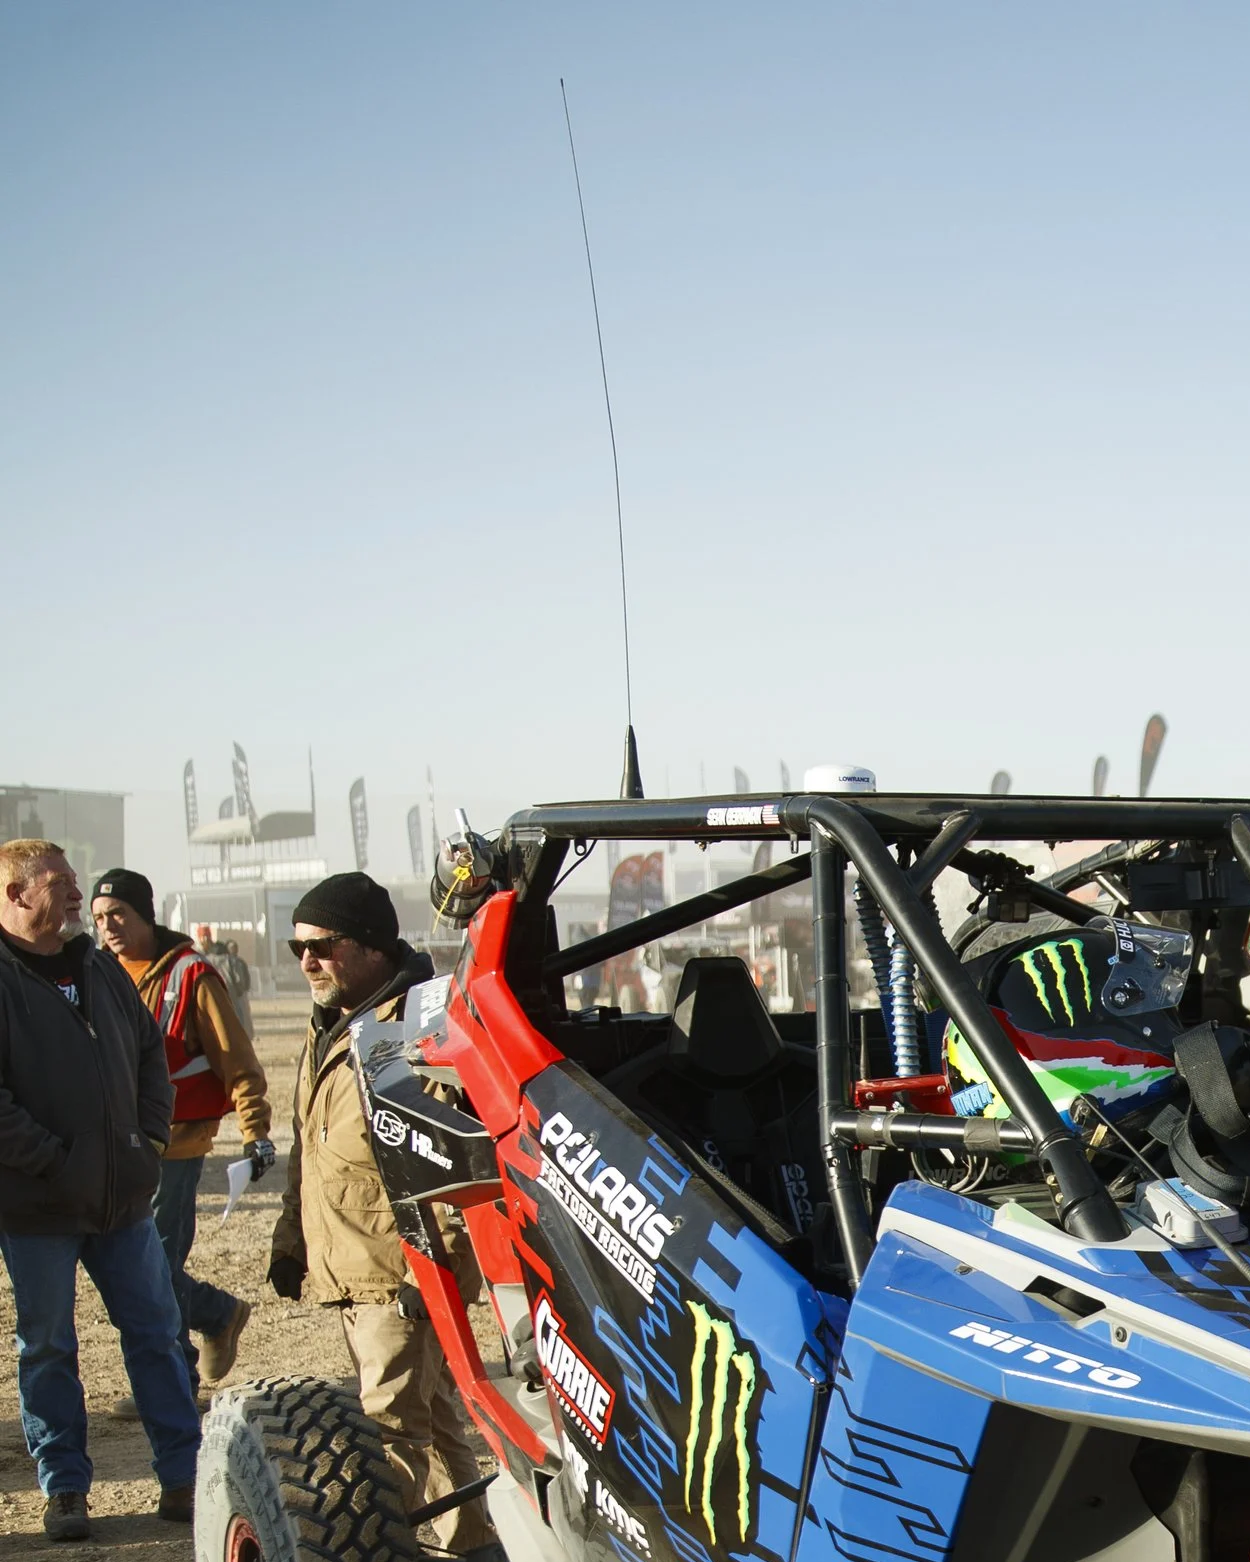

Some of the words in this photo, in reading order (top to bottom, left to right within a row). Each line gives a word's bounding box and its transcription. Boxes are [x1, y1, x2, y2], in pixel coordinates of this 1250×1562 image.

[540, 1112, 675, 1260] POLARIS
[540, 1160, 598, 1234] FACTORY
[599, 1227, 656, 1294] RACING
[535, 1298, 611, 1433] CURRIE
[948, 1321, 1142, 1389] NITTO
